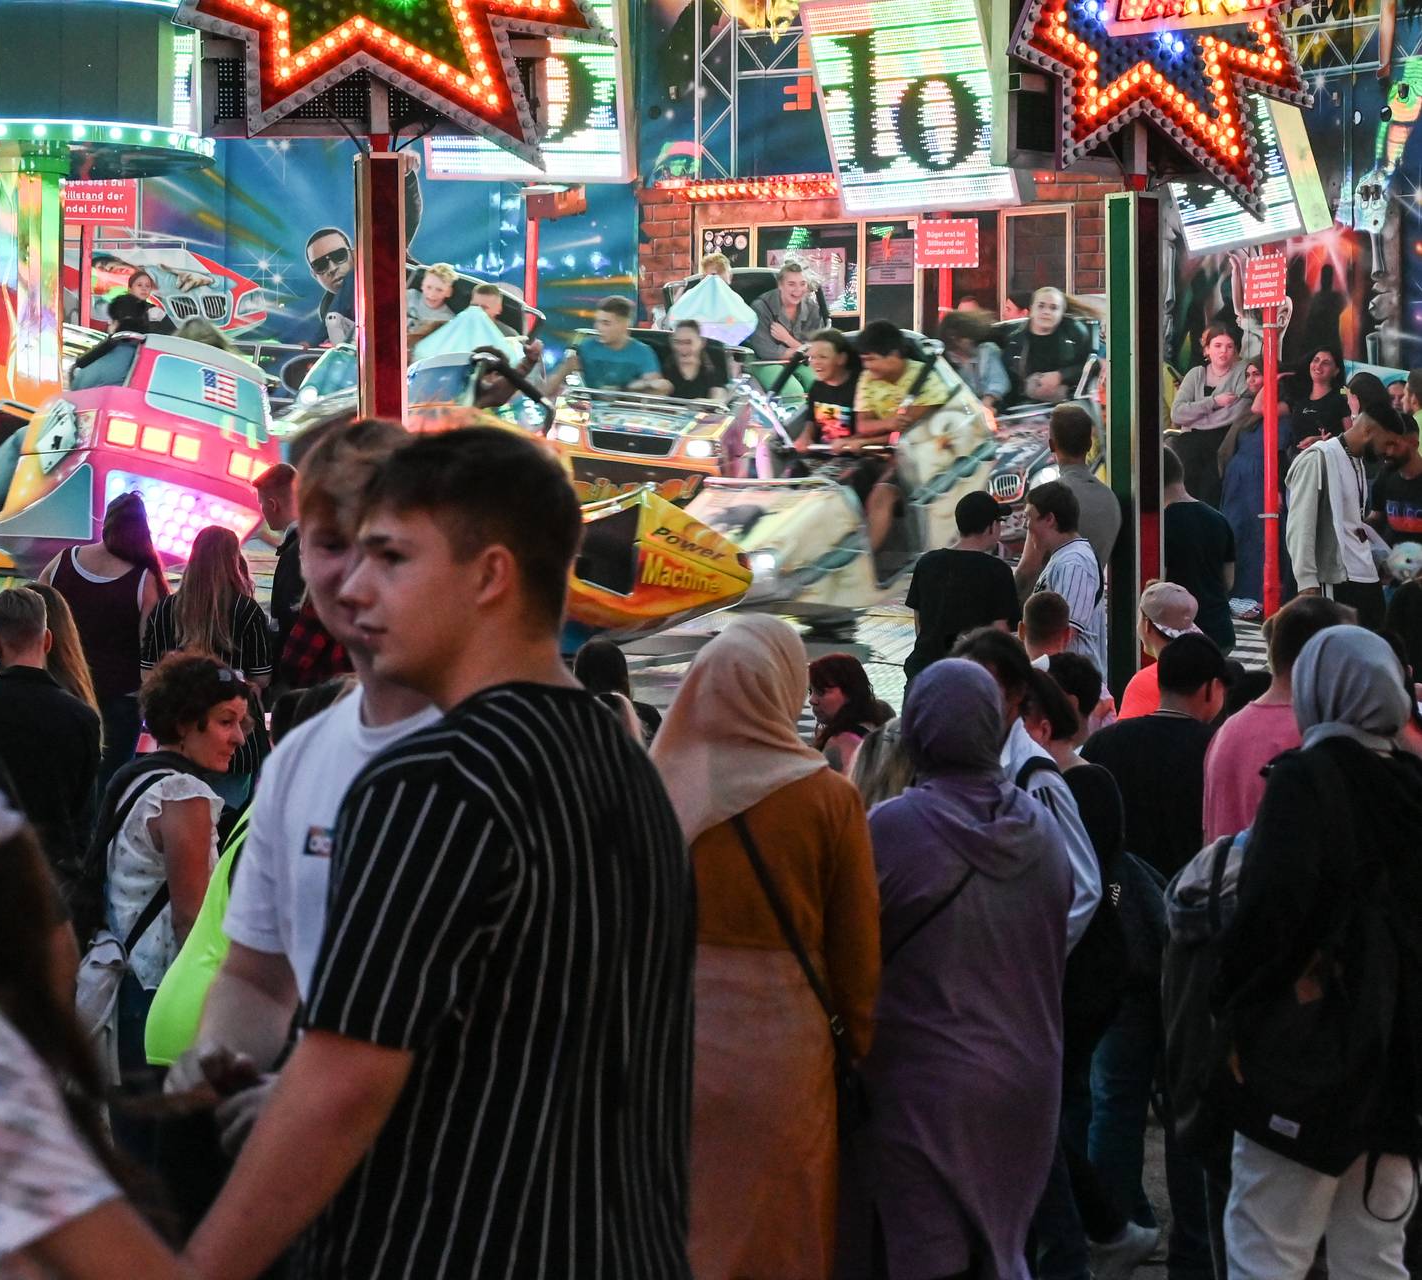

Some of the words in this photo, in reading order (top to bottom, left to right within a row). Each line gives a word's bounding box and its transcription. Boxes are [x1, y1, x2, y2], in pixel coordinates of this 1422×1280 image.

[64, 191, 104, 201] tillstand
[107, 191, 124, 200] der
[90, 204, 128, 213] öffnen!
[652, 526, 727, 561] Power
[640, 552, 722, 594] Machine
